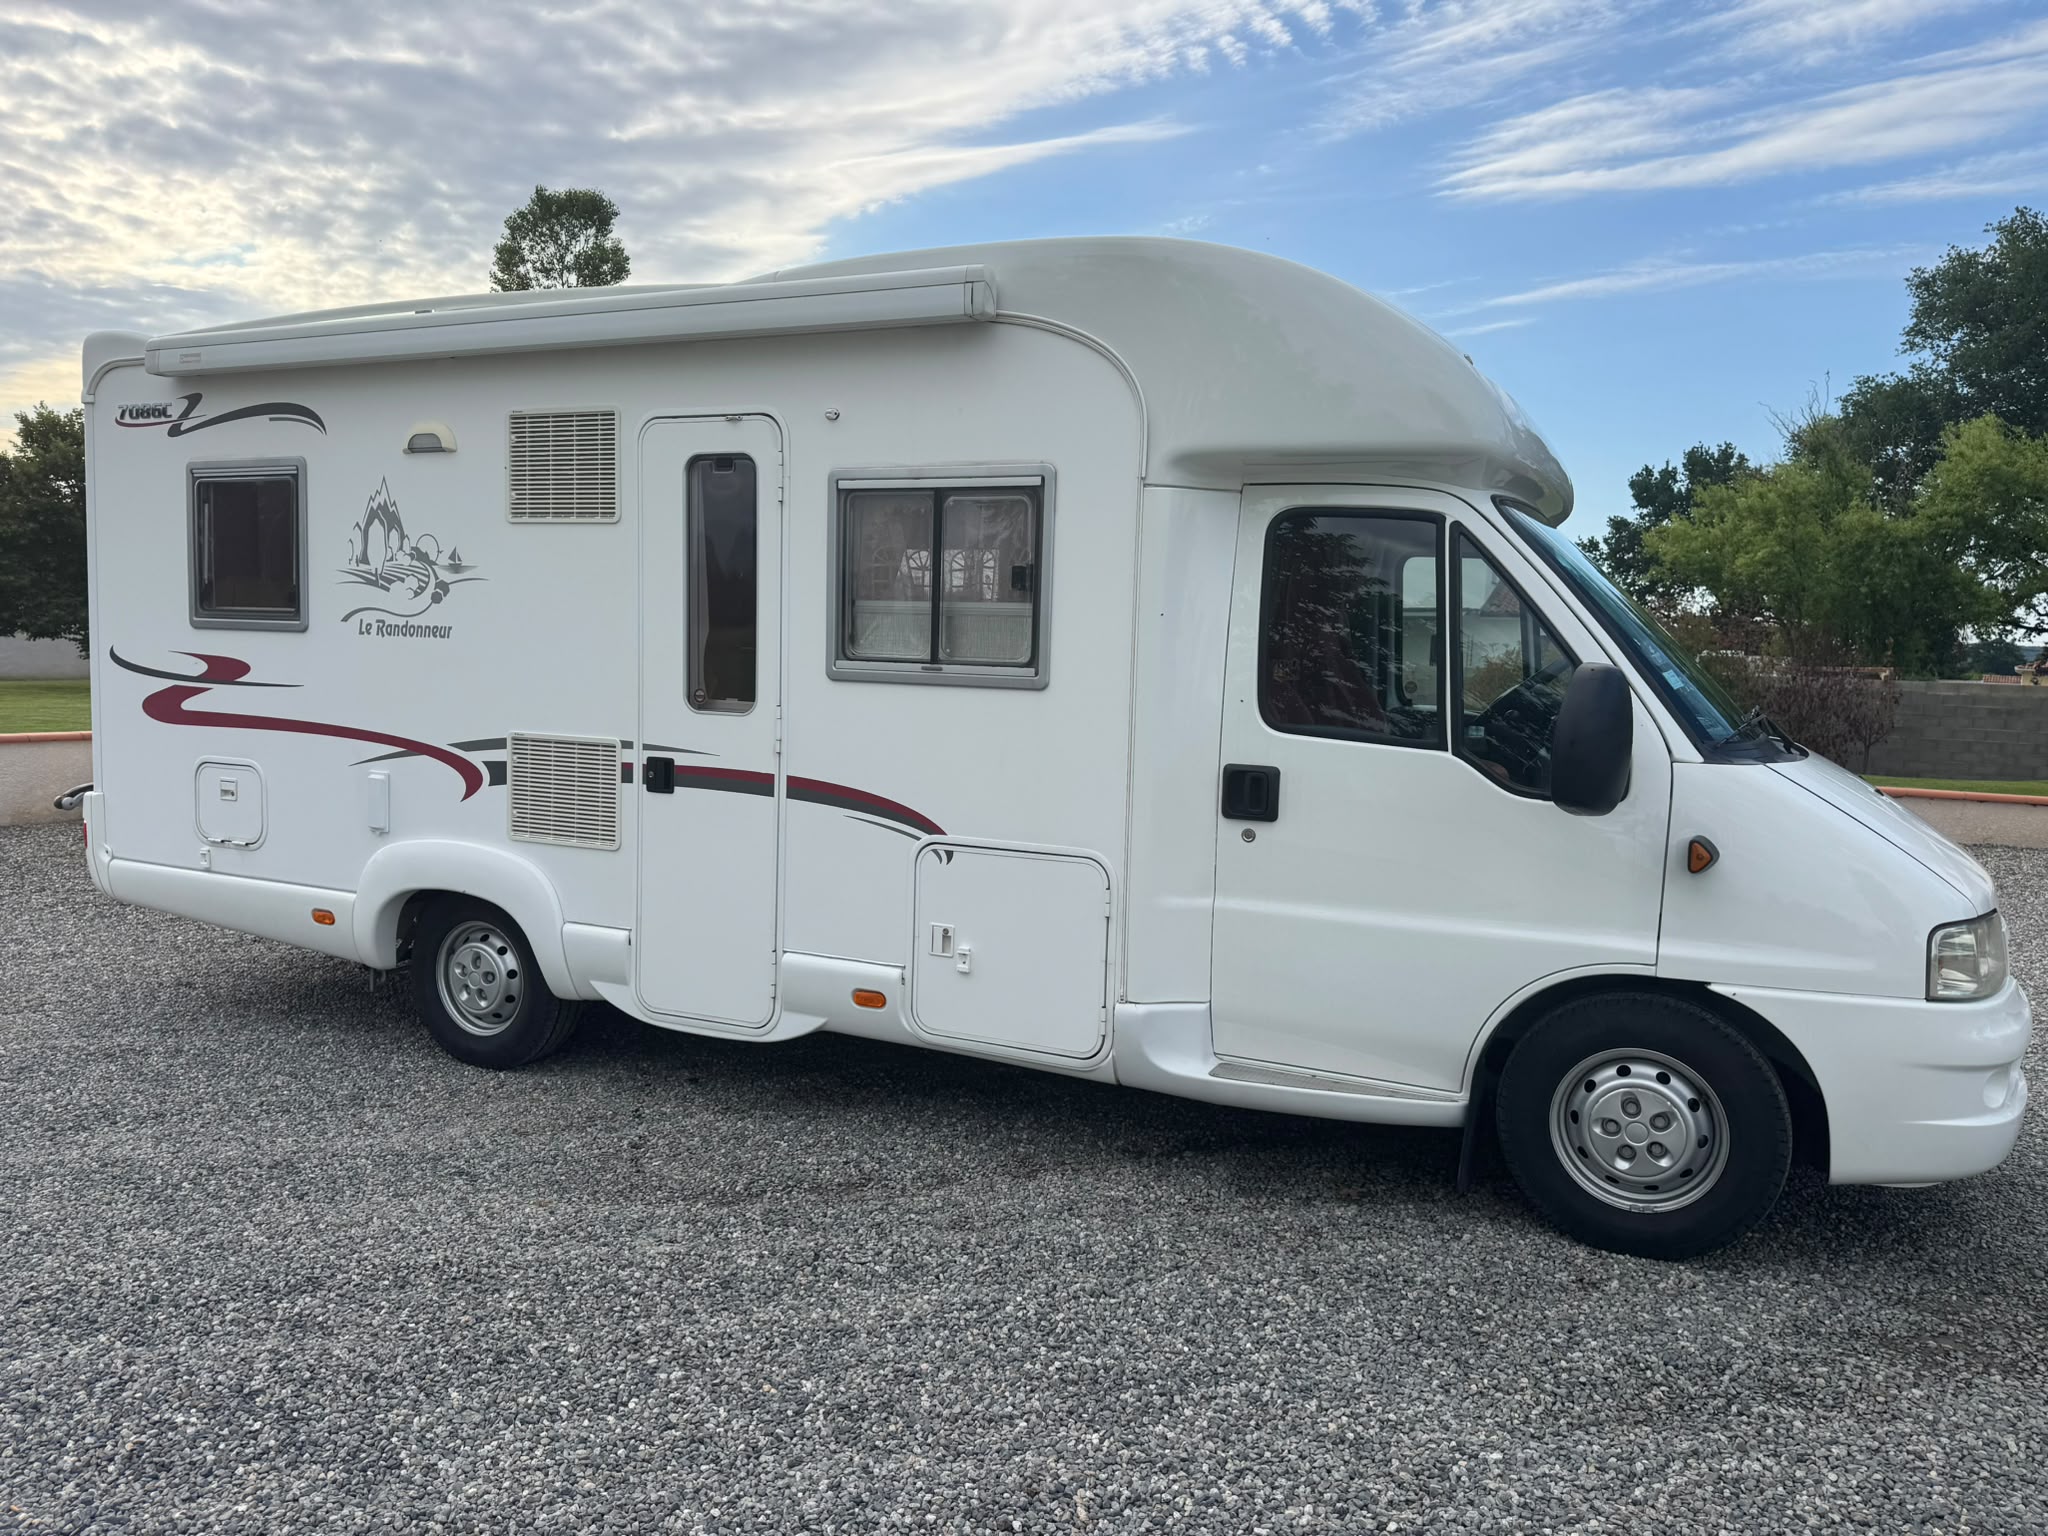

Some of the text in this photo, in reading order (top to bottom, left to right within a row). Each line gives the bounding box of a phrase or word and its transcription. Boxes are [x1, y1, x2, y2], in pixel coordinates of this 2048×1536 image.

[117, 402, 173, 421] 7086C
[358, 618, 453, 639] Le Randonneur
